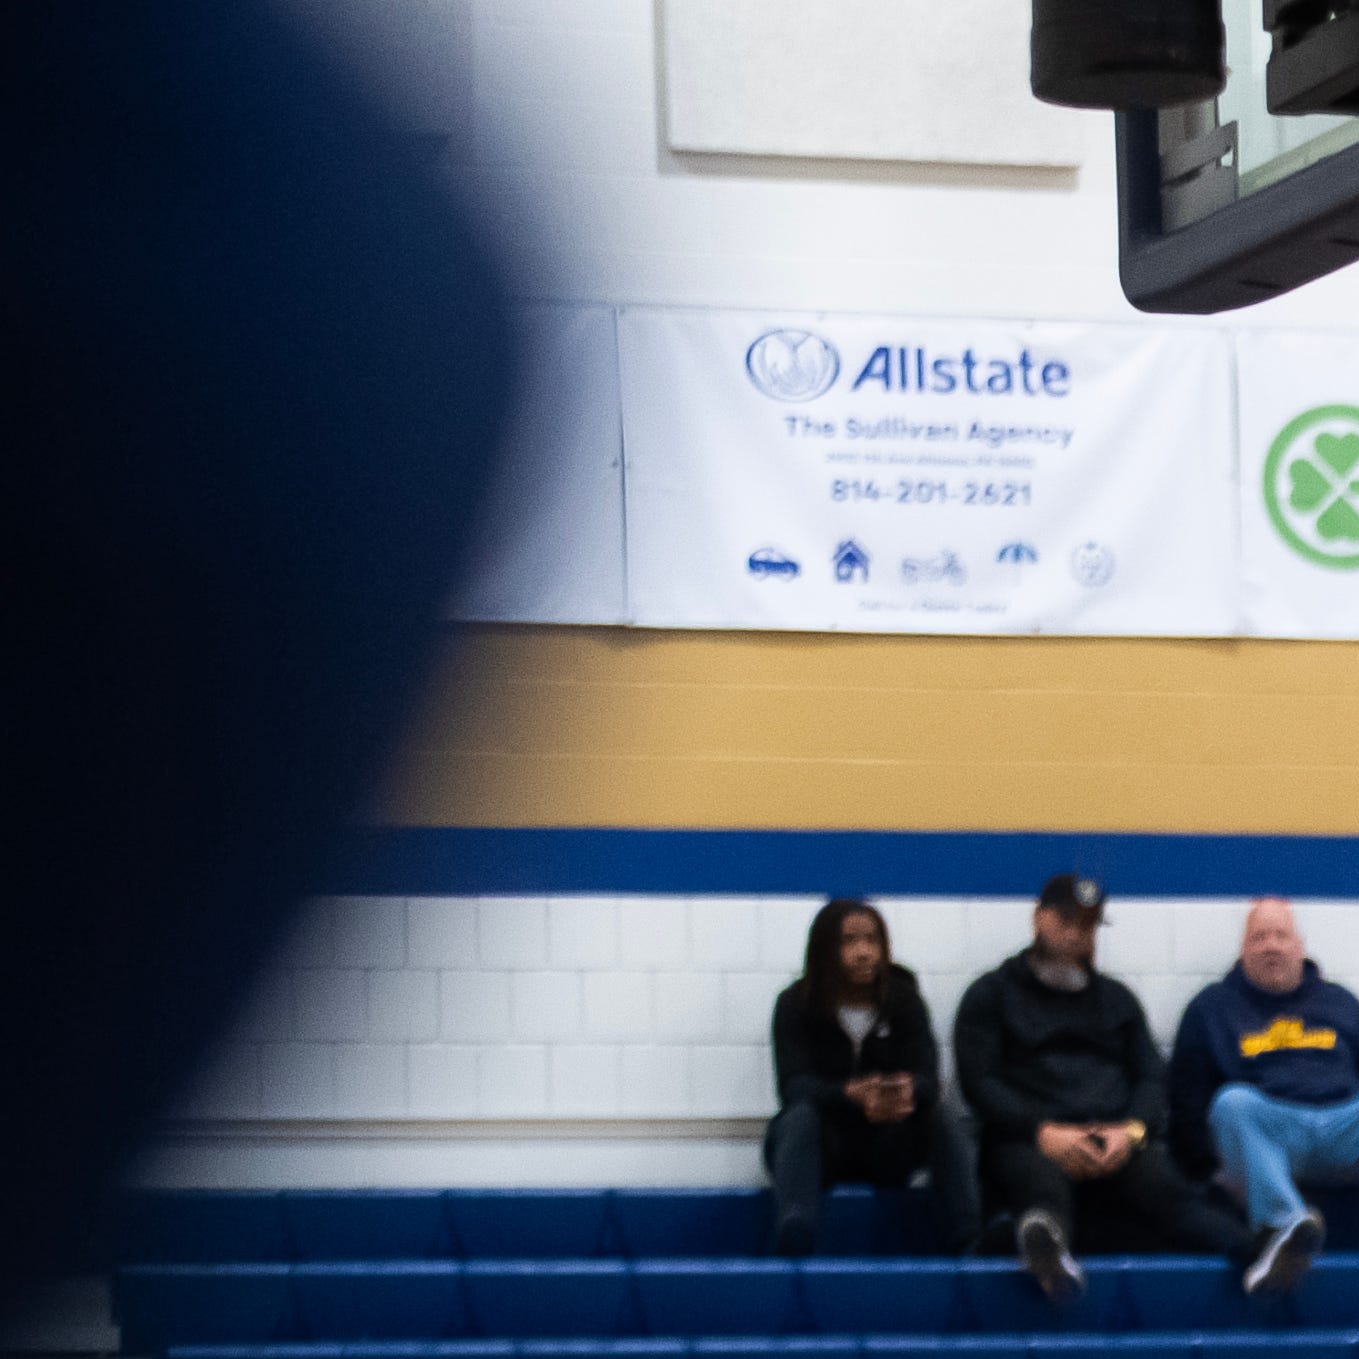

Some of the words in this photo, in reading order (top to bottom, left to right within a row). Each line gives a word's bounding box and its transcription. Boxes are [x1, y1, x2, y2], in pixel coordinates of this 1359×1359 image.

[851, 345, 1072, 398] Allstate
[785, 415, 836, 439] The
[966, 420, 1075, 449] Agency
